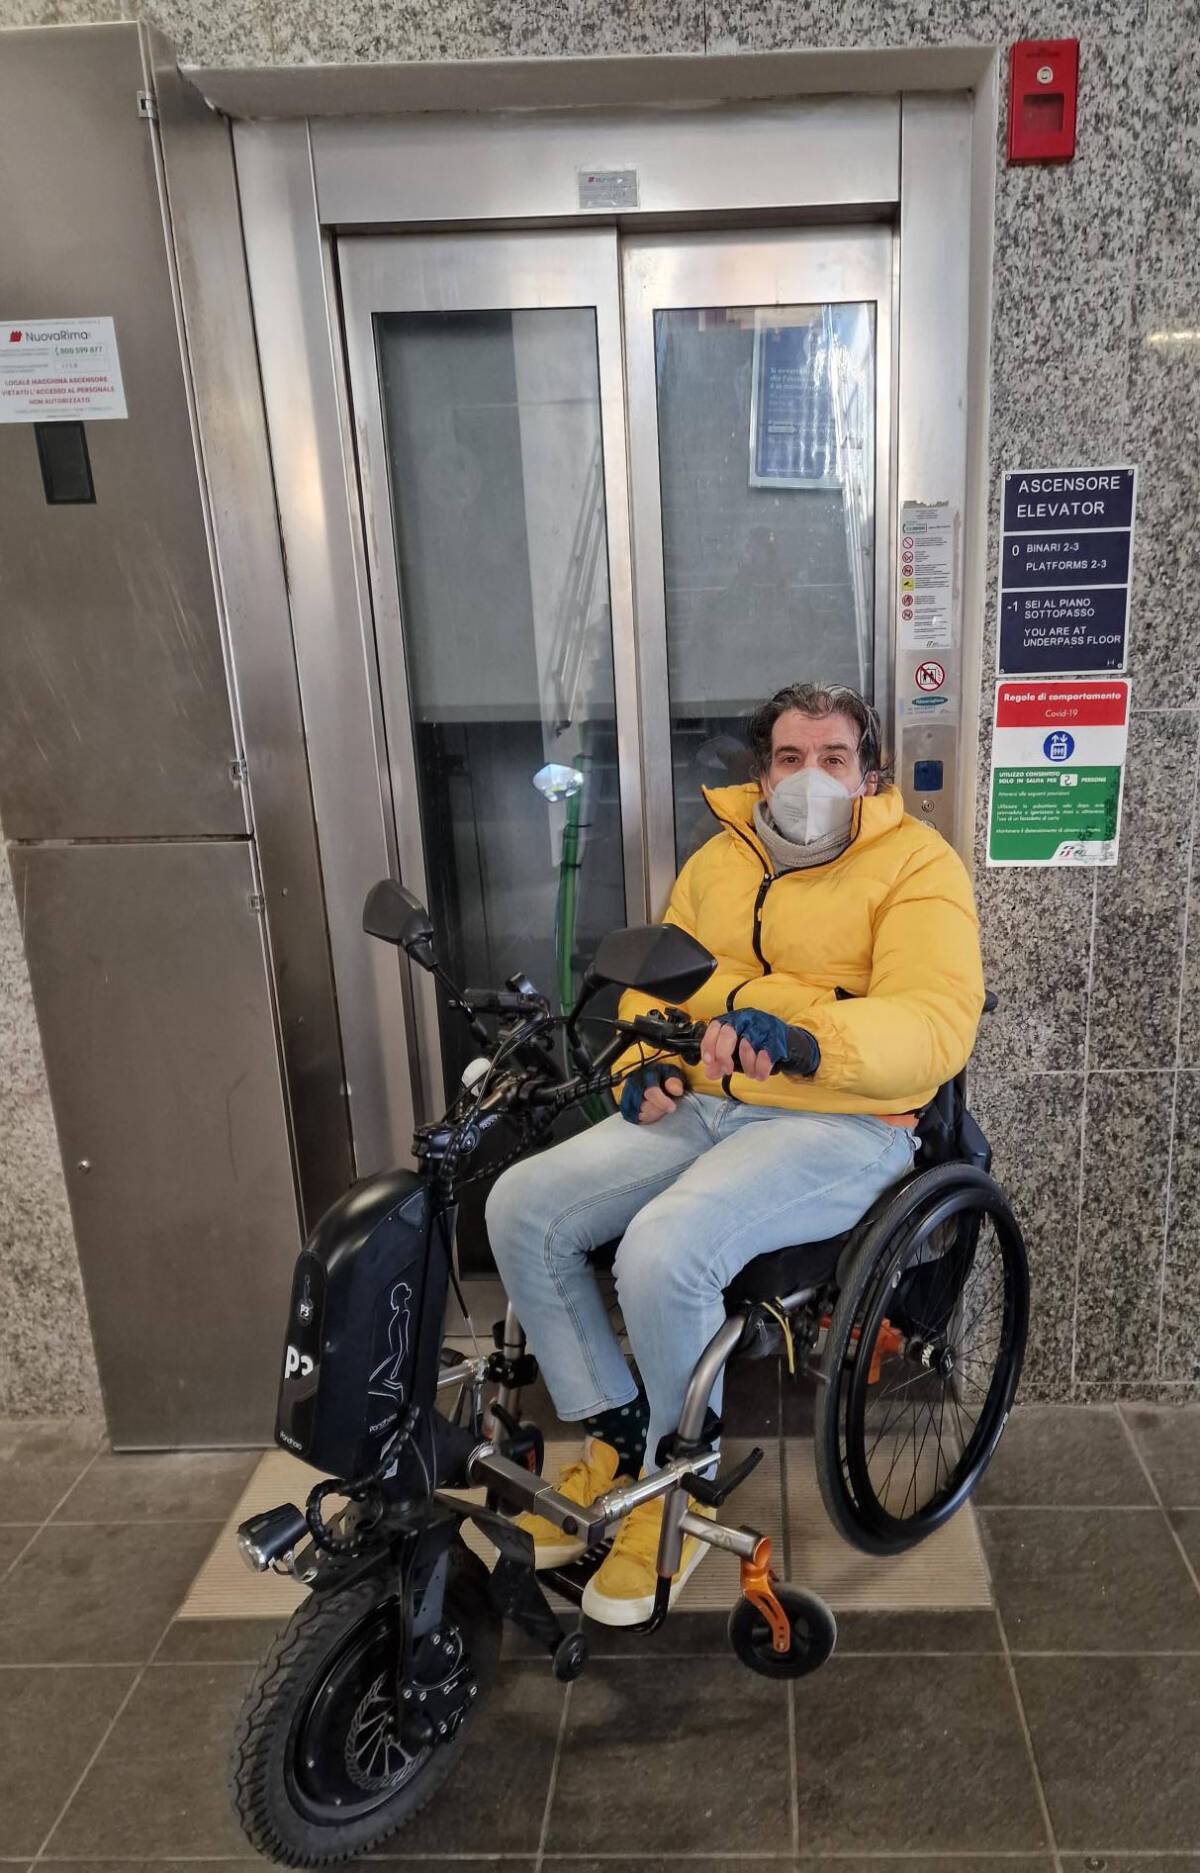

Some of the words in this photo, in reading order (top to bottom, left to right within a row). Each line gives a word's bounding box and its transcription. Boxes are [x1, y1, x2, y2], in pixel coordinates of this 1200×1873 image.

[25, 329, 88, 342] NuovaRima
[69, 376, 107, 384] ASCENSORE
[2, 388, 30, 396] VIETATO
[77, 386, 114, 394] PERSONALE
[45, 397, 90, 405] AUTORIZZATO
[1018, 476, 1120, 494] ASCENSORE
[1017, 501, 1105, 518] ELEVATOR
[1011, 544, 1020, 557] 0
[1026, 543, 1060, 553] BINARI
[1063, 542, 1080, 552] 2-3
[1026, 560, 1088, 571] PLATFORMS
[1091, 559, 1107, 569] 2-3
[1007, 600, 1018, 612] -1
[1025, 600, 1040, 609] SEI
[1044, 599, 1056, 608] AL
[1059, 598, 1091, 608] PIANO
[1024, 608, 1095, 620] SOTTOPASSO
[1024, 627, 1046, 637] YOU
[1049, 626, 1070, 636] ARE
[1073, 625, 1087, 635] AT
[1023, 636, 1084, 647] UNDERPASS
[1086, 634, 1121, 645] FLOOR
[1004, 692, 1035, 703] Regole
[1037, 692, 1047, 701] di
[1048, 692, 1122, 703] comportamento
[1045, 709, 1079, 718] Covid-19
[299, 1303, 311, 1317] P3
